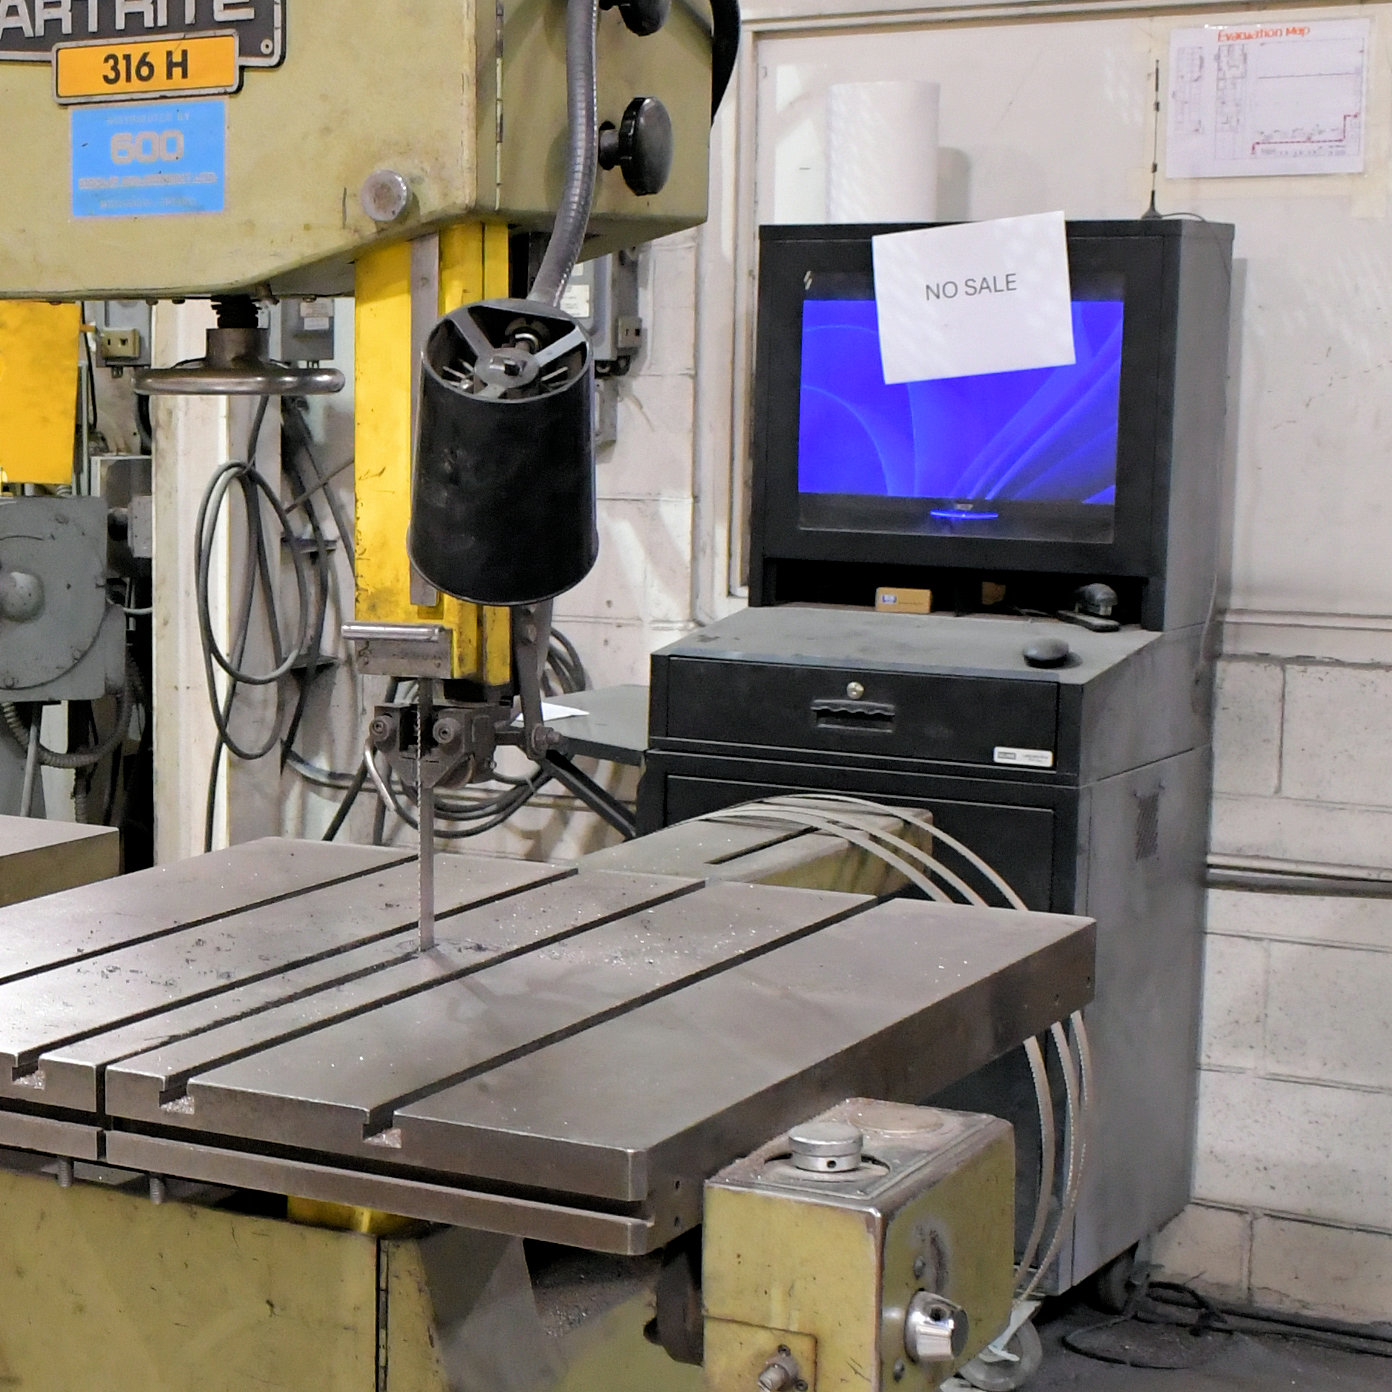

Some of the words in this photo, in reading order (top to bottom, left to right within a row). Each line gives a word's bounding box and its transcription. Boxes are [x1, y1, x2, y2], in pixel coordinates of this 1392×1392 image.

[102, 51, 155, 85] 316
[166, 49, 189, 81] H
[110, 128, 185, 165] 600
[925, 281, 958, 301] NO
[964, 273, 1017, 296] SALE
